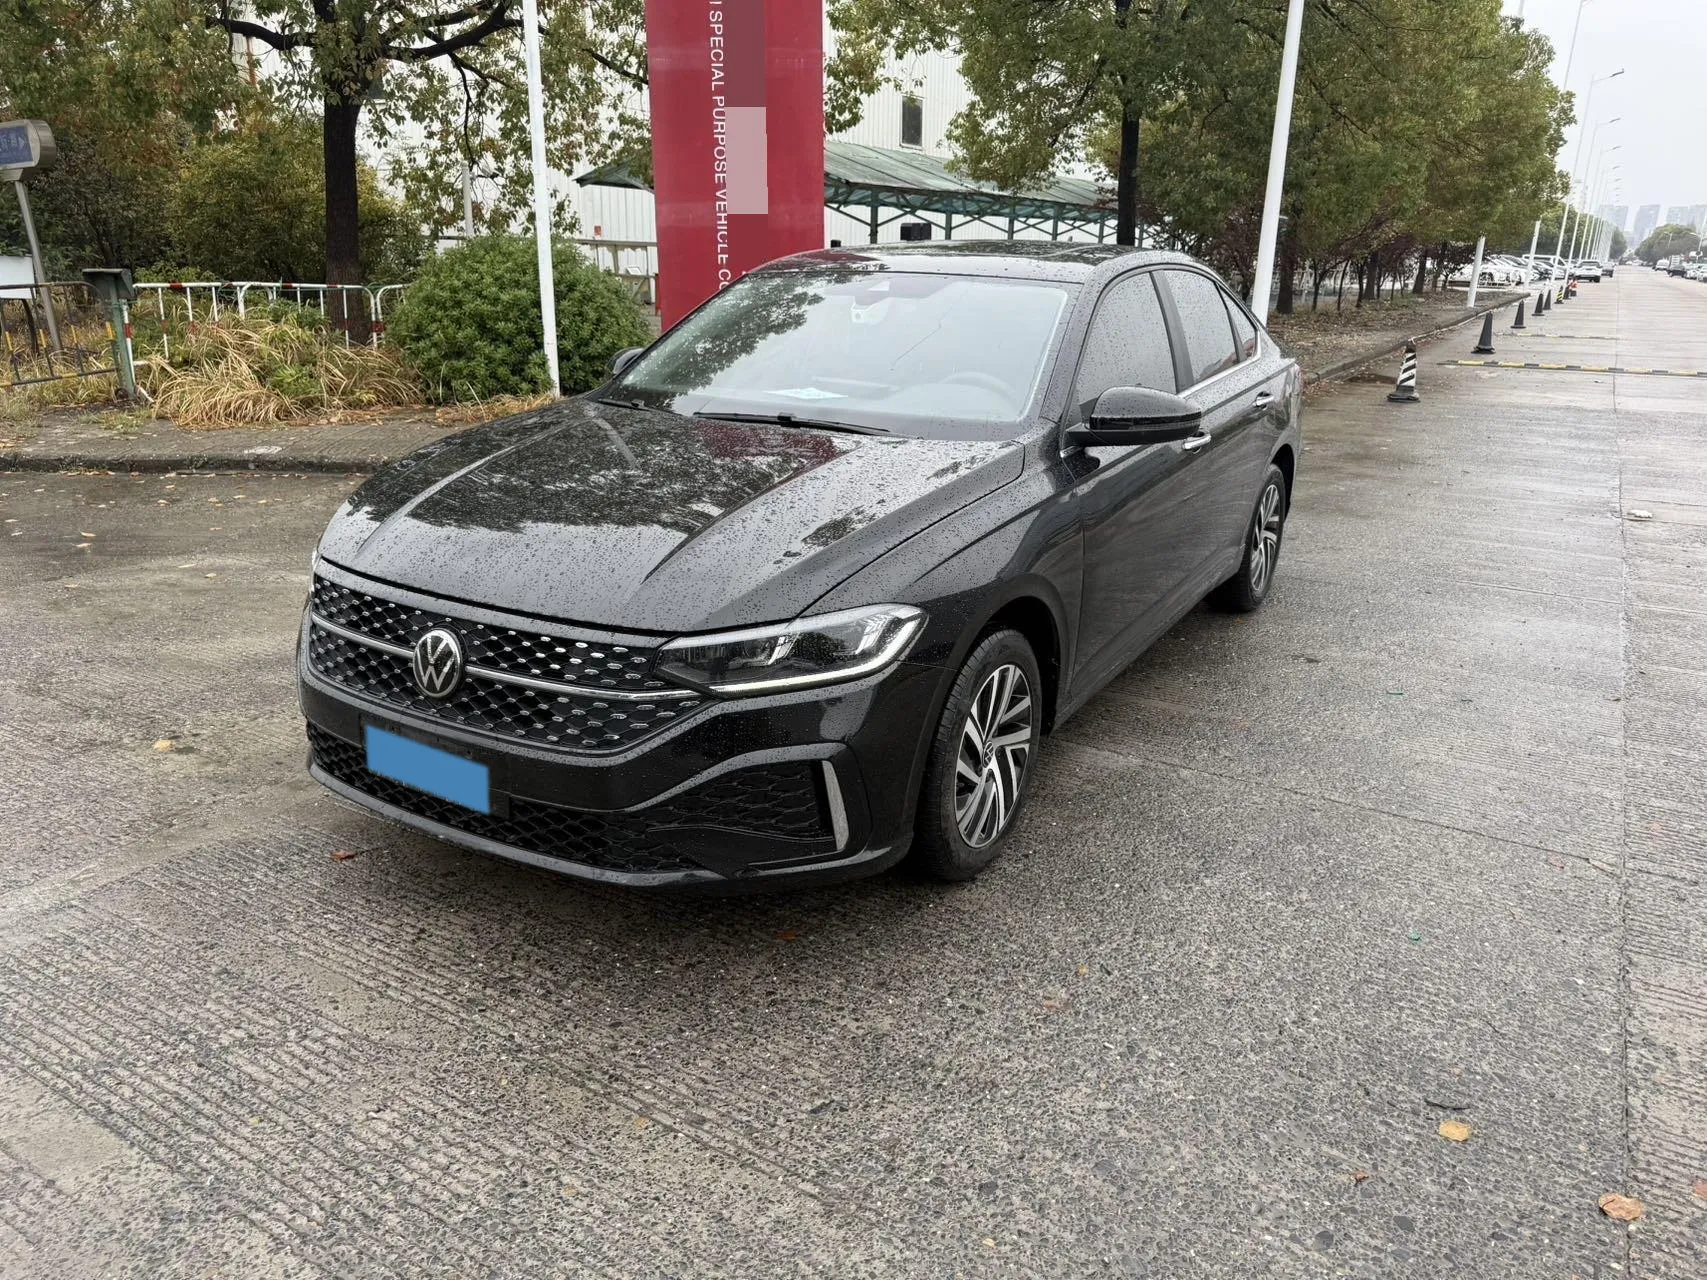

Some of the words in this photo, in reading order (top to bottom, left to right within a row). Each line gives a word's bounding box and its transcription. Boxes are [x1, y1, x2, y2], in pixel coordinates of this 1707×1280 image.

[709, 10, 724, 91] SPECIAL
[712, 96, 727, 184] PURPOSE
[715, 188, 729, 265] VEHICLE
